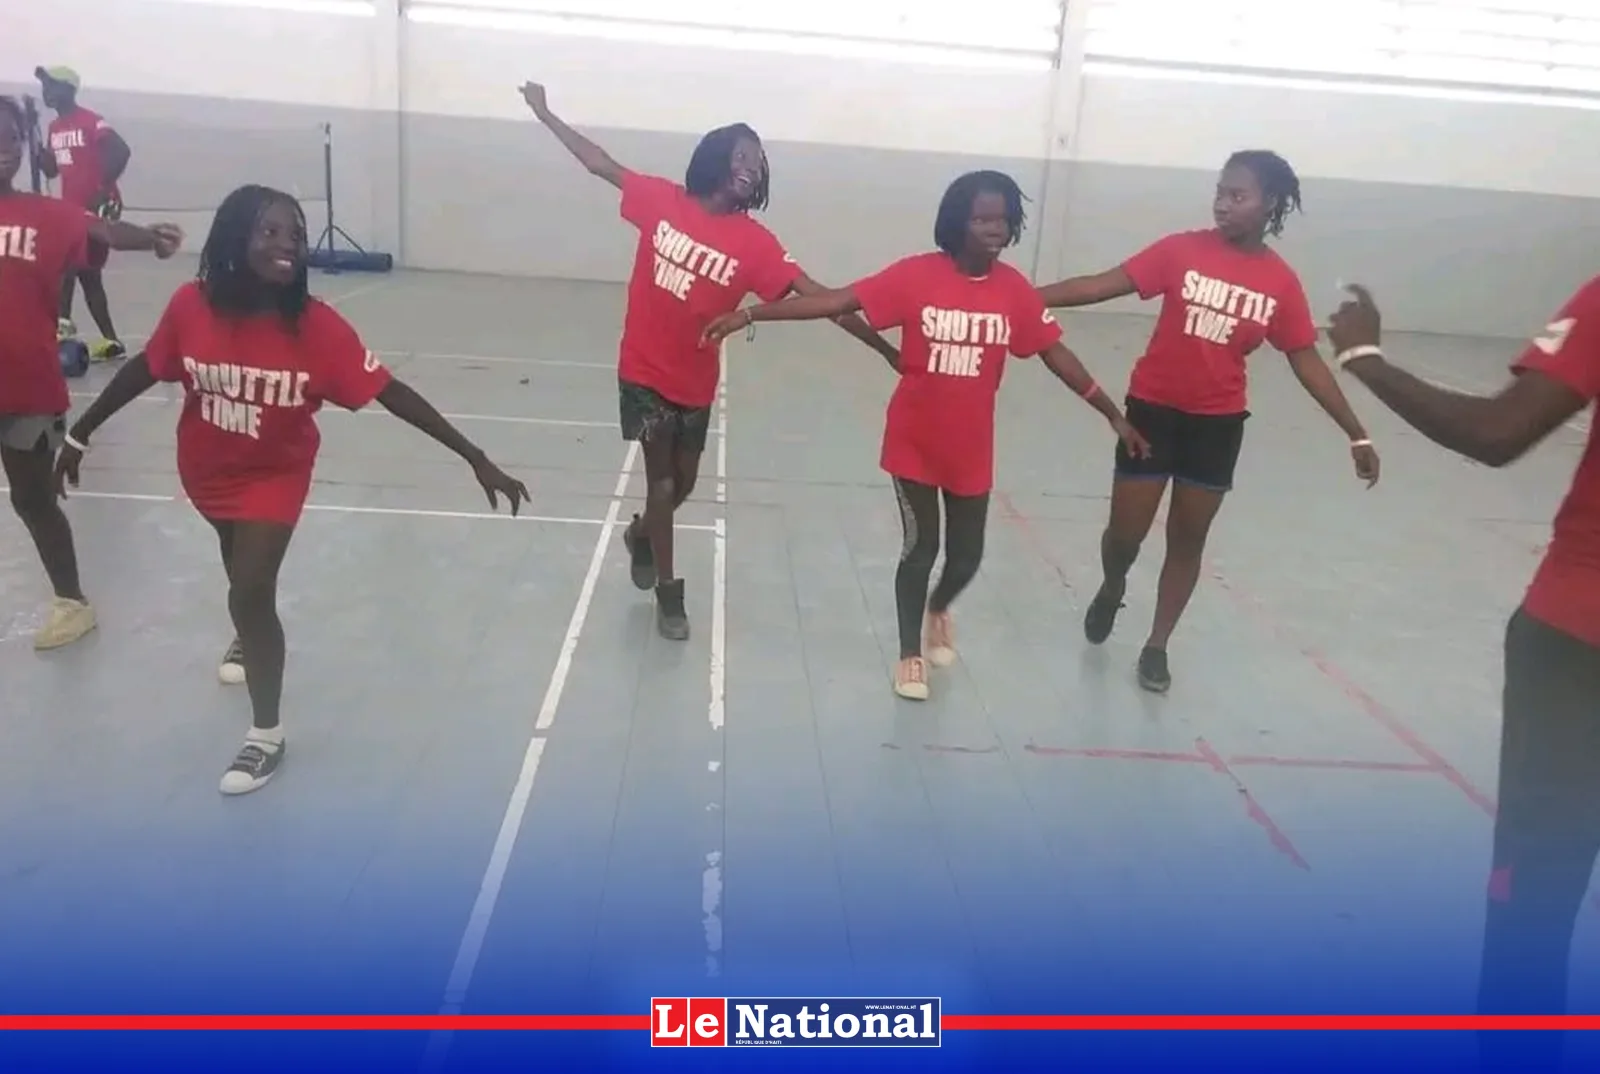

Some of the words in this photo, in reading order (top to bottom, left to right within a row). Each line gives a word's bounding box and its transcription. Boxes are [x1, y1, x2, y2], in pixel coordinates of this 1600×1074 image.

[653, 220, 739, 287] SHUTTLE
[653, 253, 696, 301] TIME
[1181, 270, 1277, 326] SHUTTLE
[1184, 305, 1238, 344] TIME
[927, 343, 984, 376] TIME
[200, 393, 262, 439] TIME
